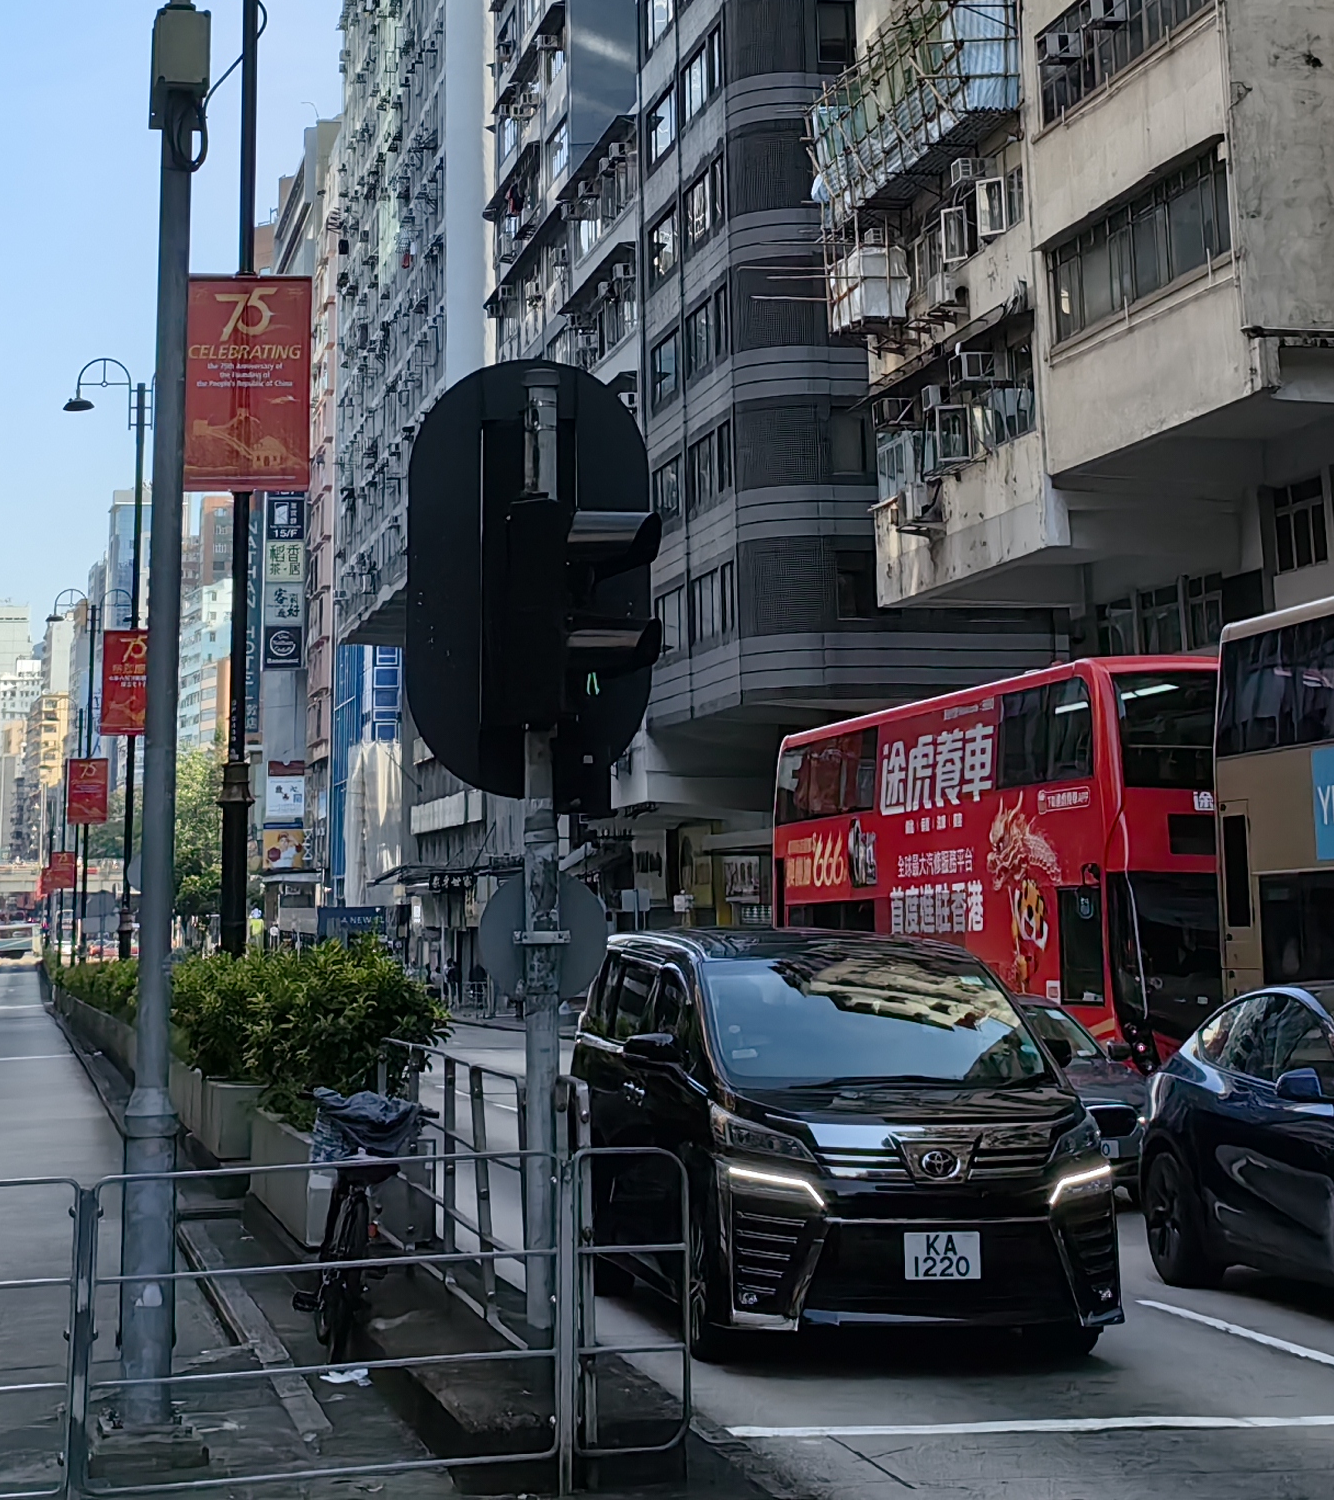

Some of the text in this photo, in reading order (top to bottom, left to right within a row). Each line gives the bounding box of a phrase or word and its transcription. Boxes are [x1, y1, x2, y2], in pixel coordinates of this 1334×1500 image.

[214, 287, 278, 341] 75
[188, 344, 302, 360] CELEBRATING
[273, 529, 298, 538] 15/F
[120, 635, 147, 663] 75
[879, 722, 995, 816] 途虎養車
[889, 879, 984, 934] 首度進駐香港
[926, 1234, 958, 1256] KA
[914, 1256, 970, 1277] 1220
